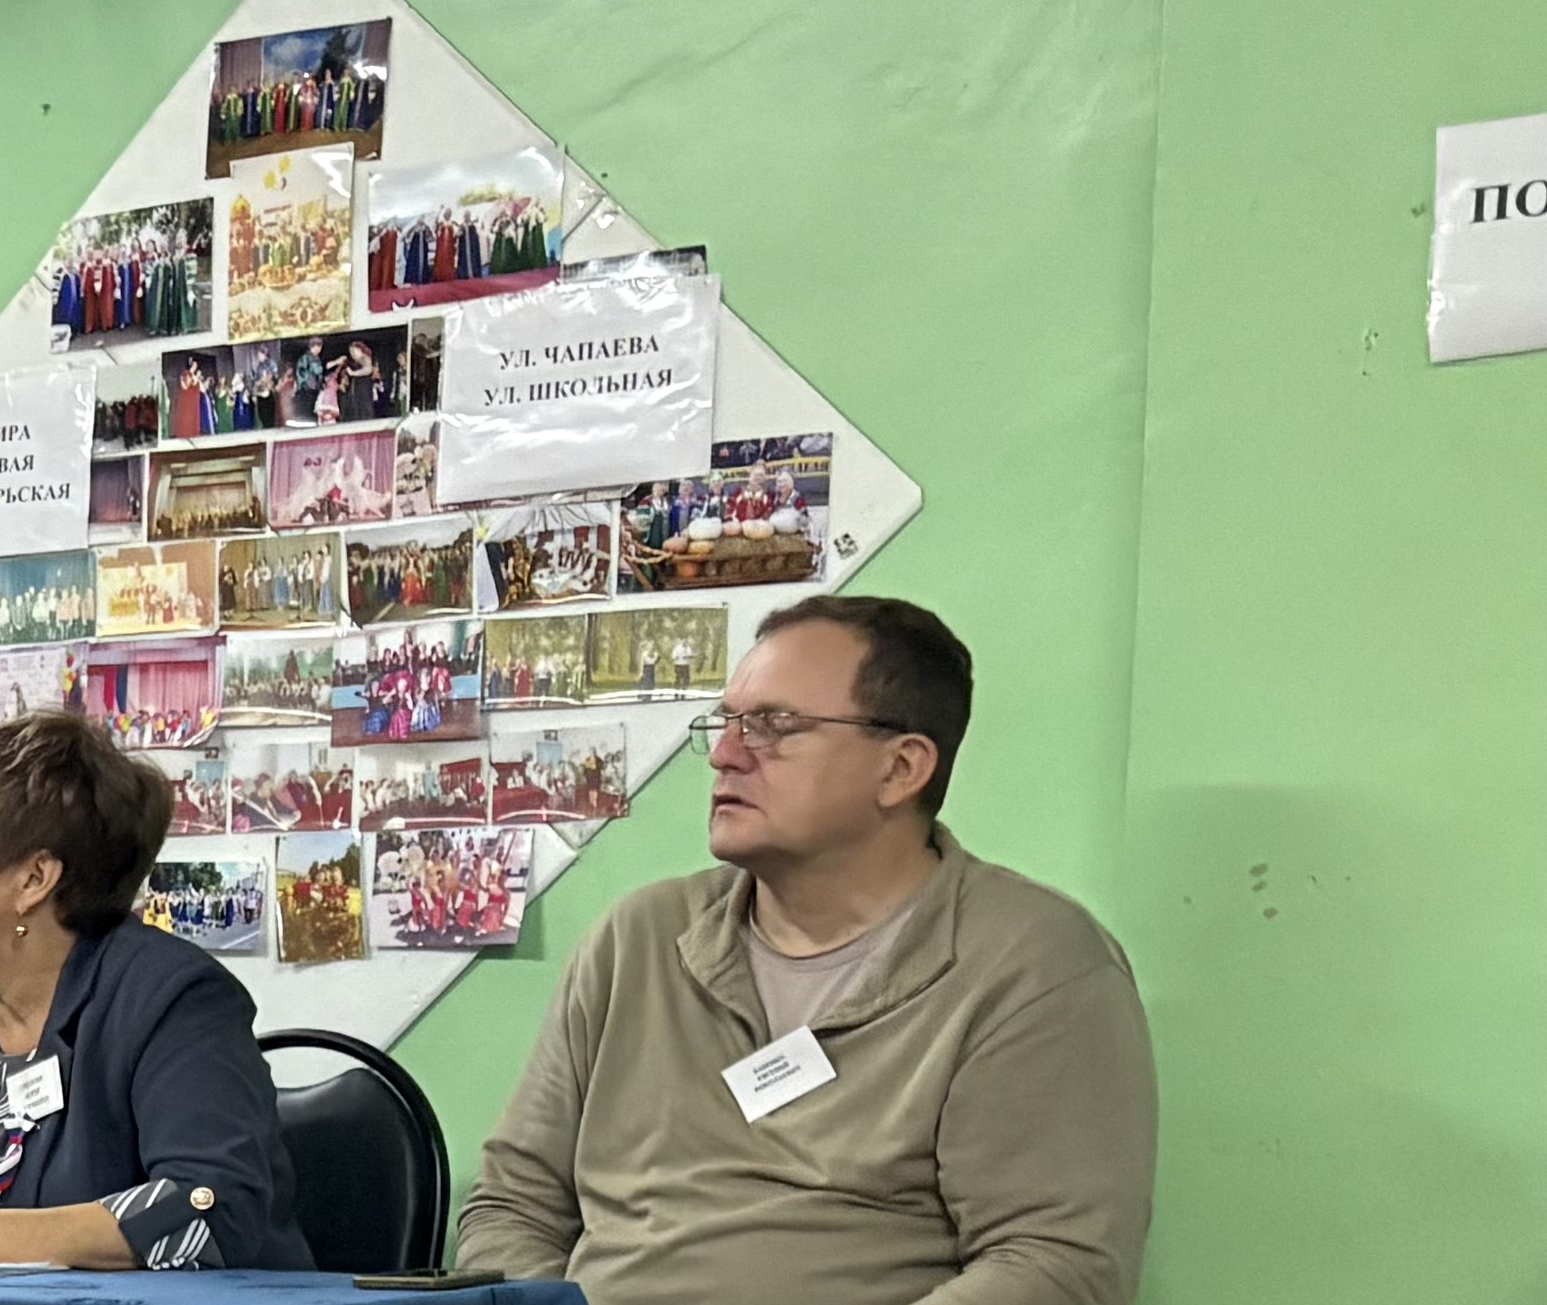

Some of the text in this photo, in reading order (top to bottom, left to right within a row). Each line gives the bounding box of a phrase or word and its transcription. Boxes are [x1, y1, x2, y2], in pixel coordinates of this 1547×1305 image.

[499, 334, 660, 371] УЛ. ЧАПАЕВА
[483, 368, 673, 407] УЛ. ШКОЛЬНАЯ
